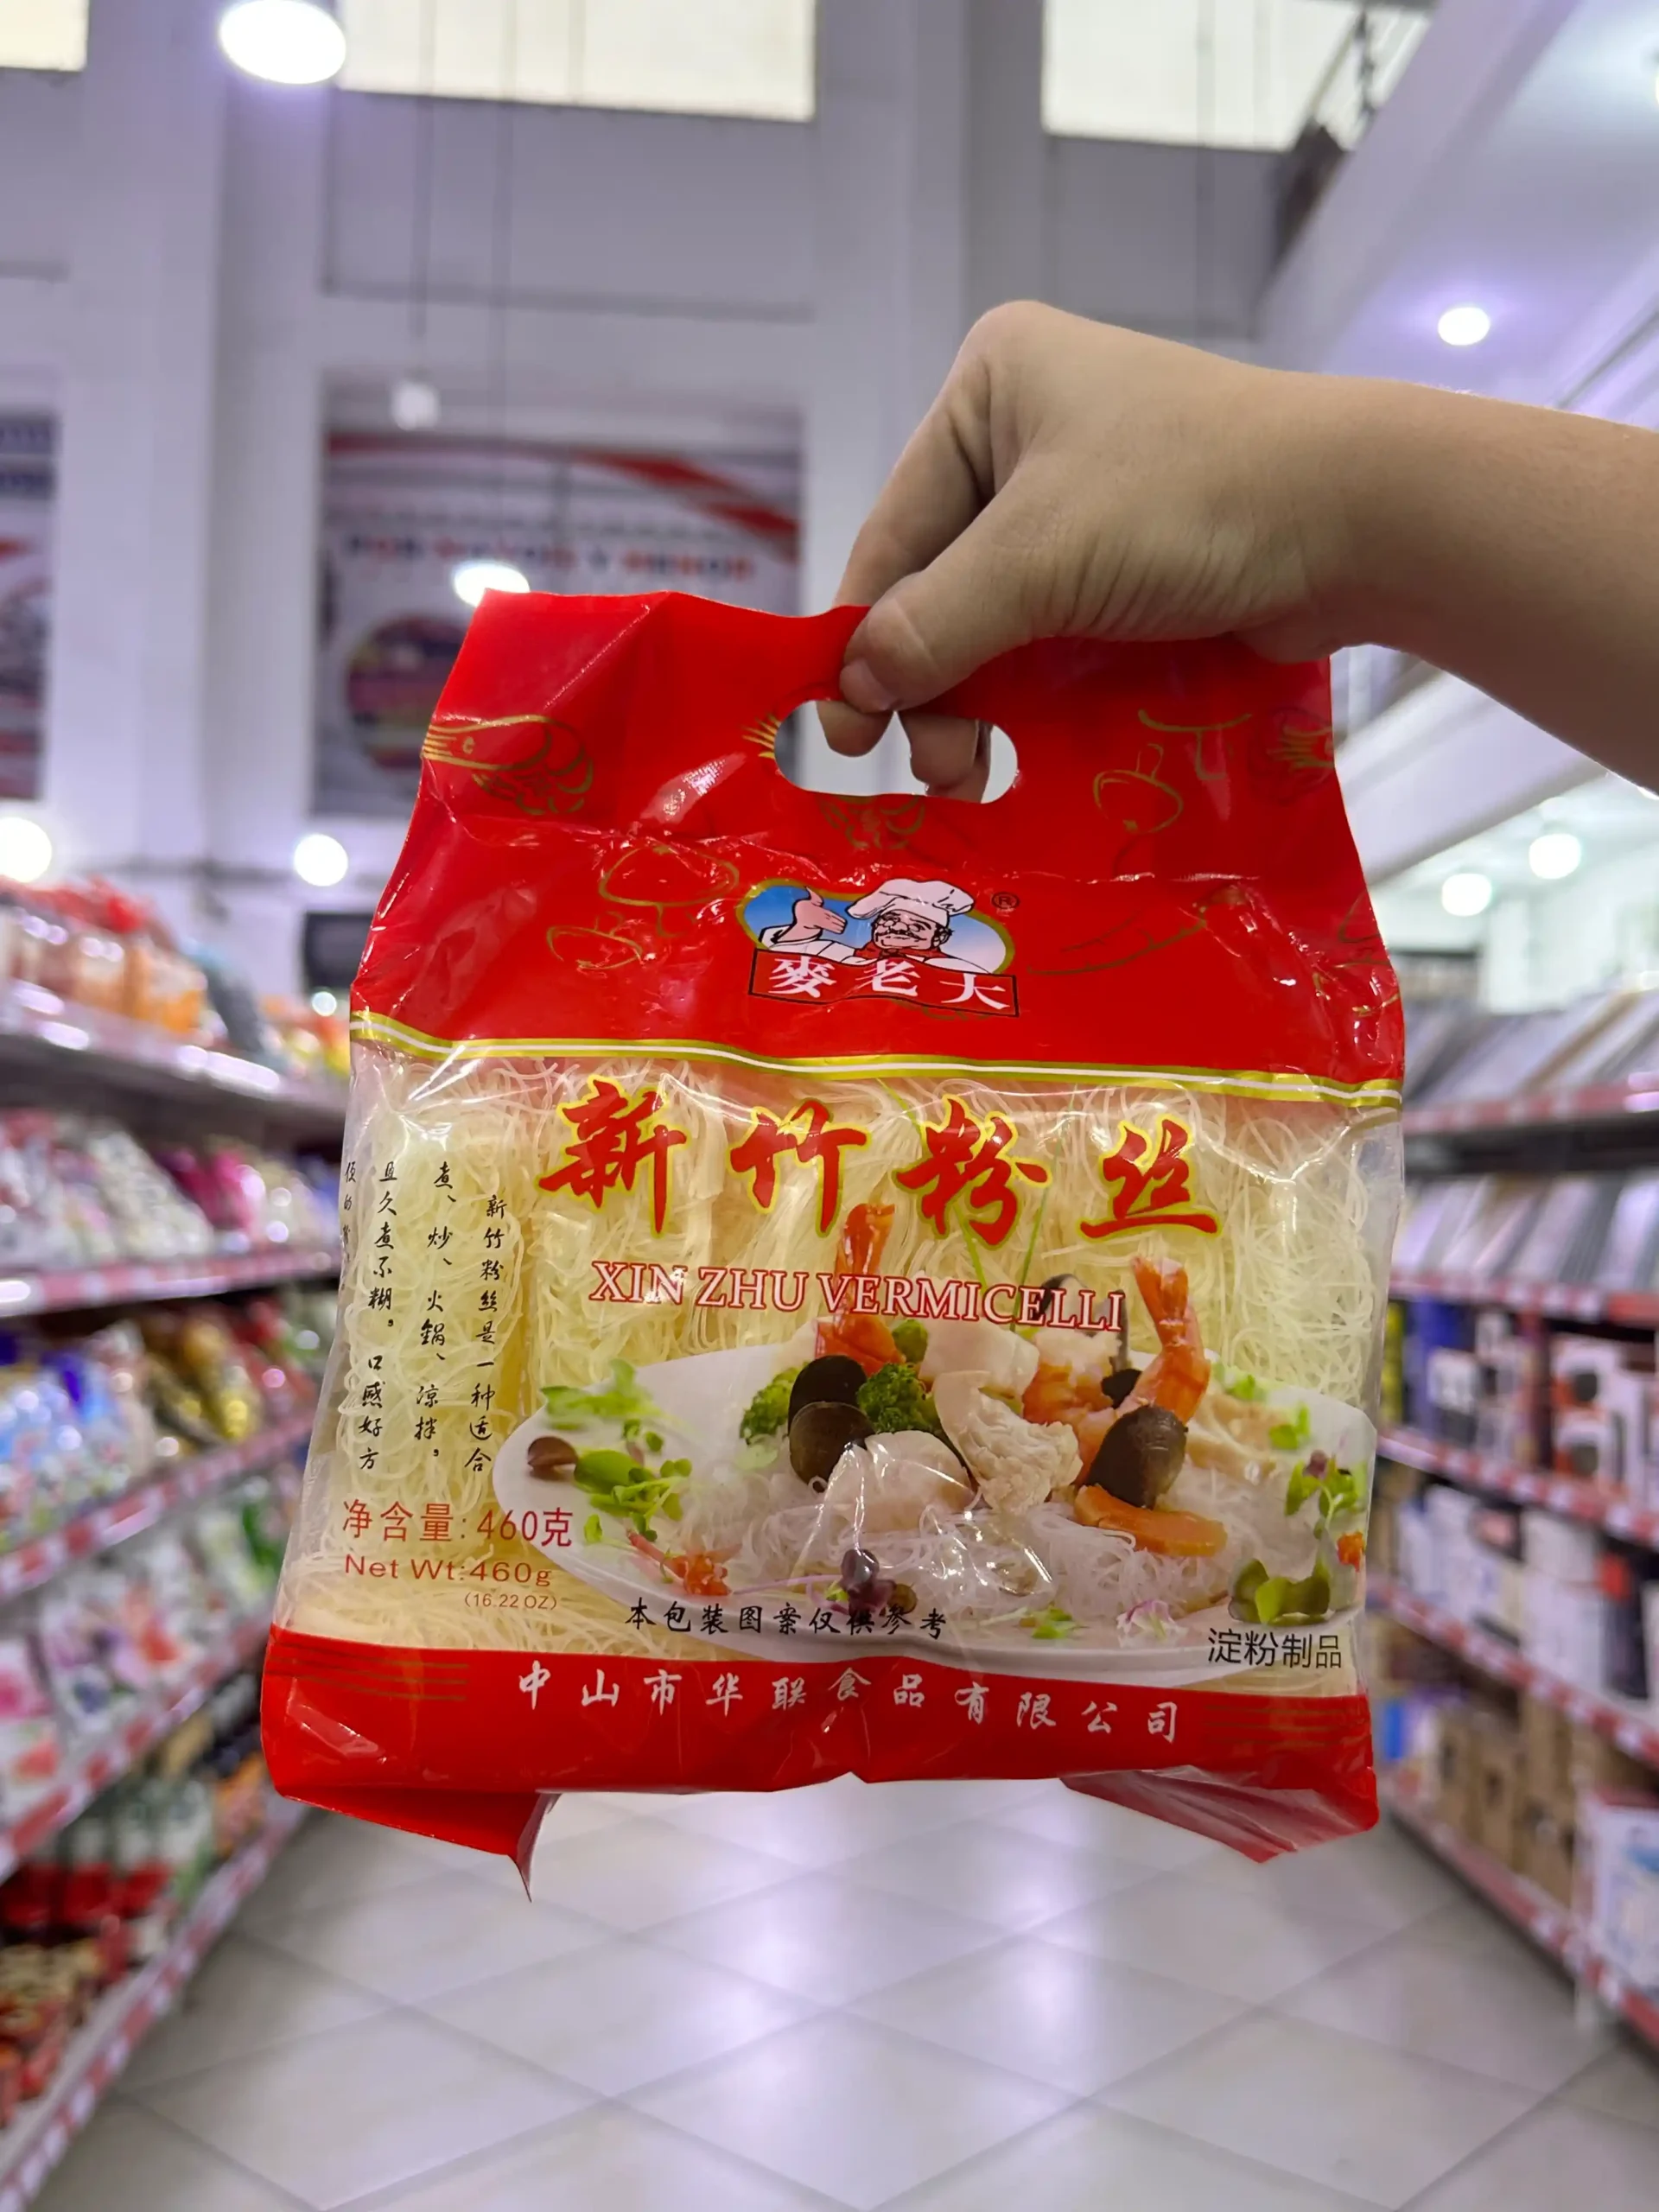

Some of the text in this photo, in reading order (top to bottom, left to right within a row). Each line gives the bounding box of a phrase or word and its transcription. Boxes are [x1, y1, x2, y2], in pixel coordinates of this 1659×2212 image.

[538, 1074, 1223, 1250] 新竹粉丝
[589, 1261, 1125, 1332] XIN ZHU VERMICELLI
[346, 1554, 399, 1580] Net
[464, 1592, 557, 1611] (16.22 OZ)
[625, 1597, 948, 1640] 本包装图案仅供参考
[1207, 1627, 1342, 1669] 淀粉制品
[518, 1659, 1180, 1744] 中山市华联食品有限公司
